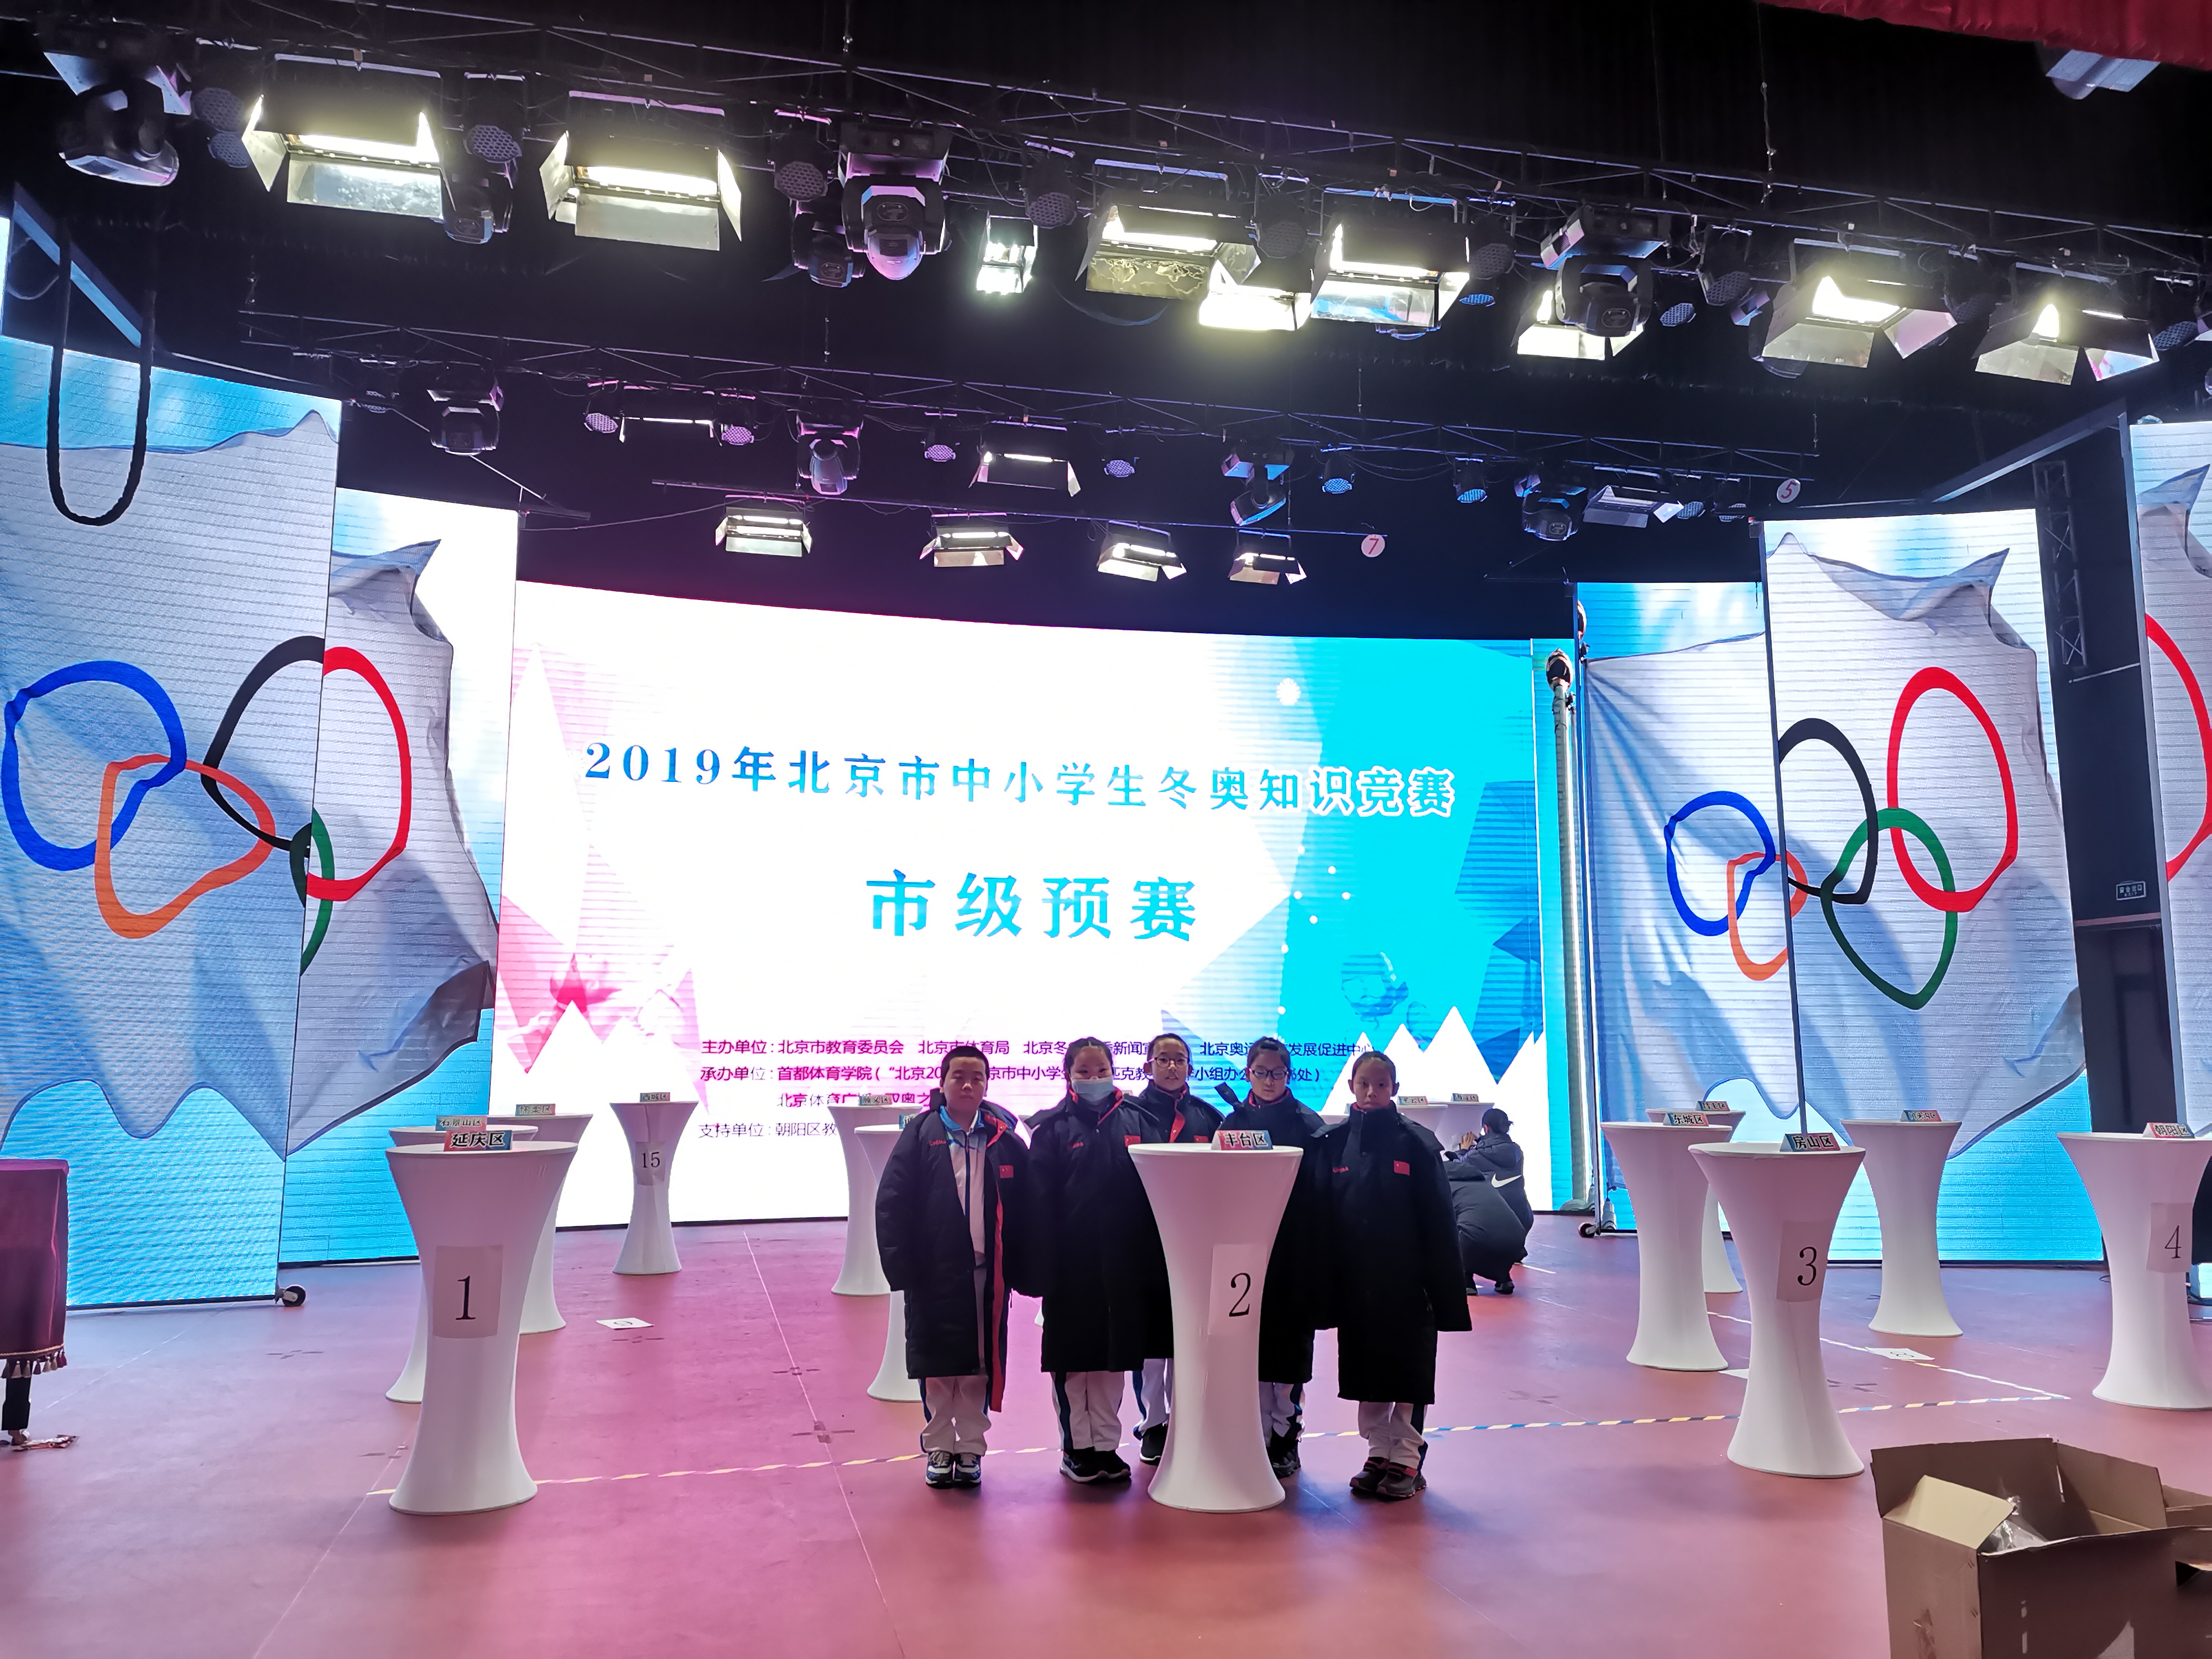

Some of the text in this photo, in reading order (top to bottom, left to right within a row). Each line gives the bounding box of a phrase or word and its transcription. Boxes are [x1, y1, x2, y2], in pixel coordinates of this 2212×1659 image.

[1781, 481, 1797, 499] 5
[1368, 538, 1379, 555] 7
[585, 742, 1453, 816] 2019年北京市中小学生冬奥知识竞赛
[866, 868, 1196, 942] 市级预赛
[440, 1118, 482, 1127] 石景山区
[1672, 1113, 1704, 1125] 东城区
[2154, 1124, 2191, 1136] 朝阳区
[450, 1131, 504, 1147] 延庆区
[1224, 1131, 1267, 1147] 丰台区
[1793, 1135, 1835, 1149] 房山区
[641, 1151, 660, 1168] 15
[2164, 1225, 2182, 1259] 4
[1797, 1246, 1817, 1286] 3
[455, 1275, 476, 1321] 1
[1229, 1272, 1251, 1317] 2
